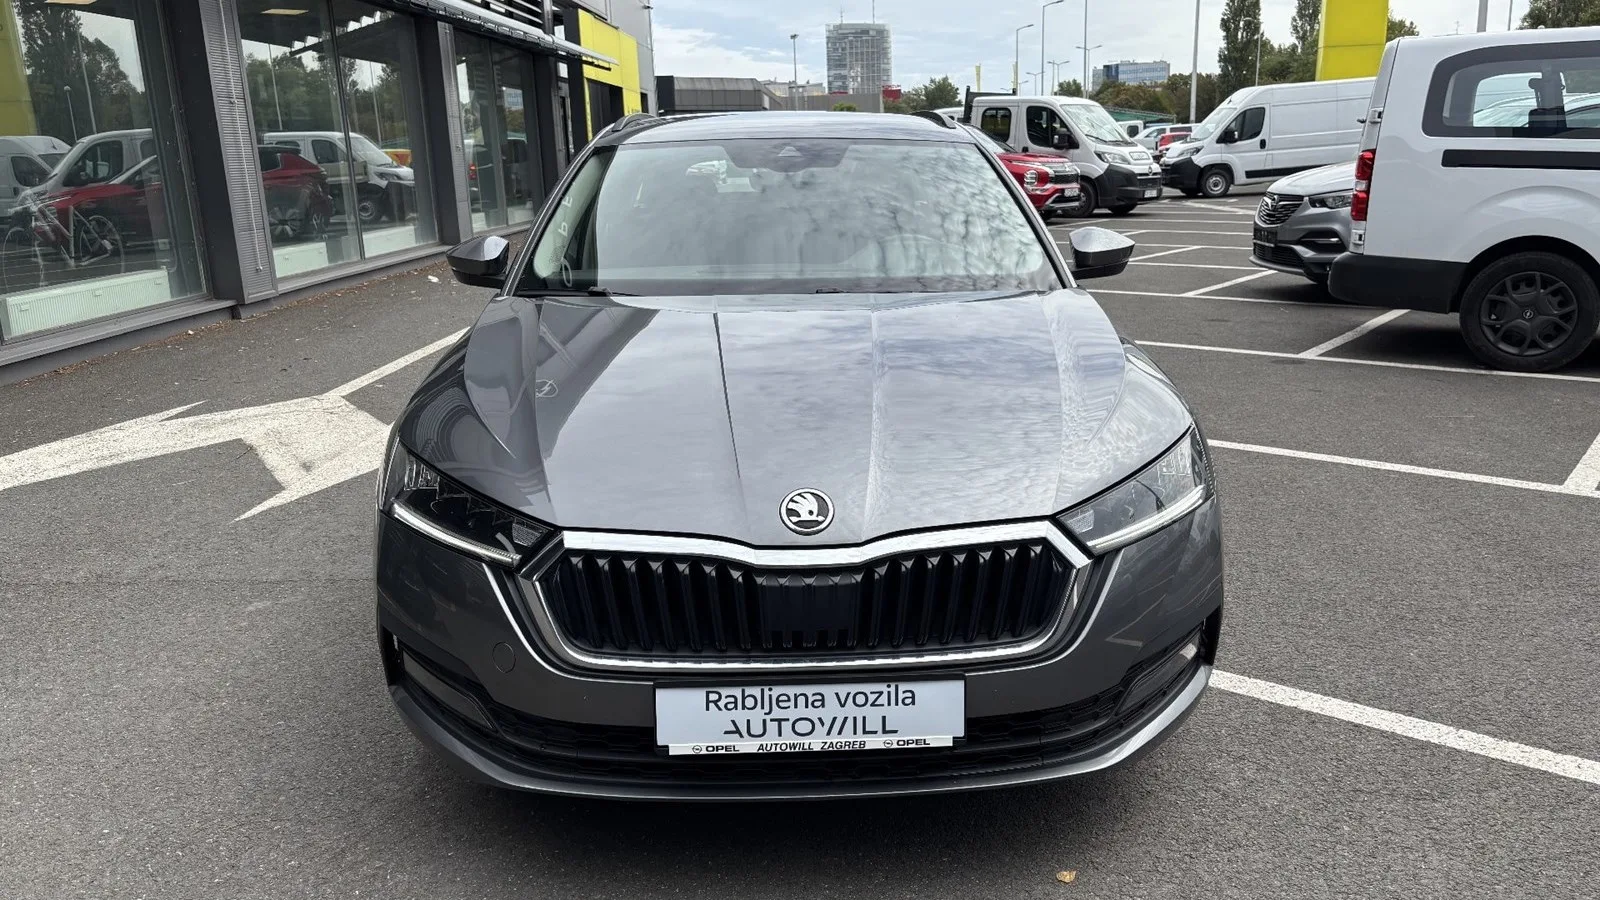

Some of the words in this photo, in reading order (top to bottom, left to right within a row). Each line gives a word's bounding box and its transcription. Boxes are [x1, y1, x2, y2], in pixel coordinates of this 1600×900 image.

[705, 686, 825, 715] Rabljena
[834, 683, 916, 708] vozila
[723, 715, 899, 738] AUTOWILL
[705, 745, 740, 753] OPEL
[756, 742, 814, 752] AUTOWILL
[820, 740, 867, 750] ZAGREB
[896, 738, 931, 747] OPEL
